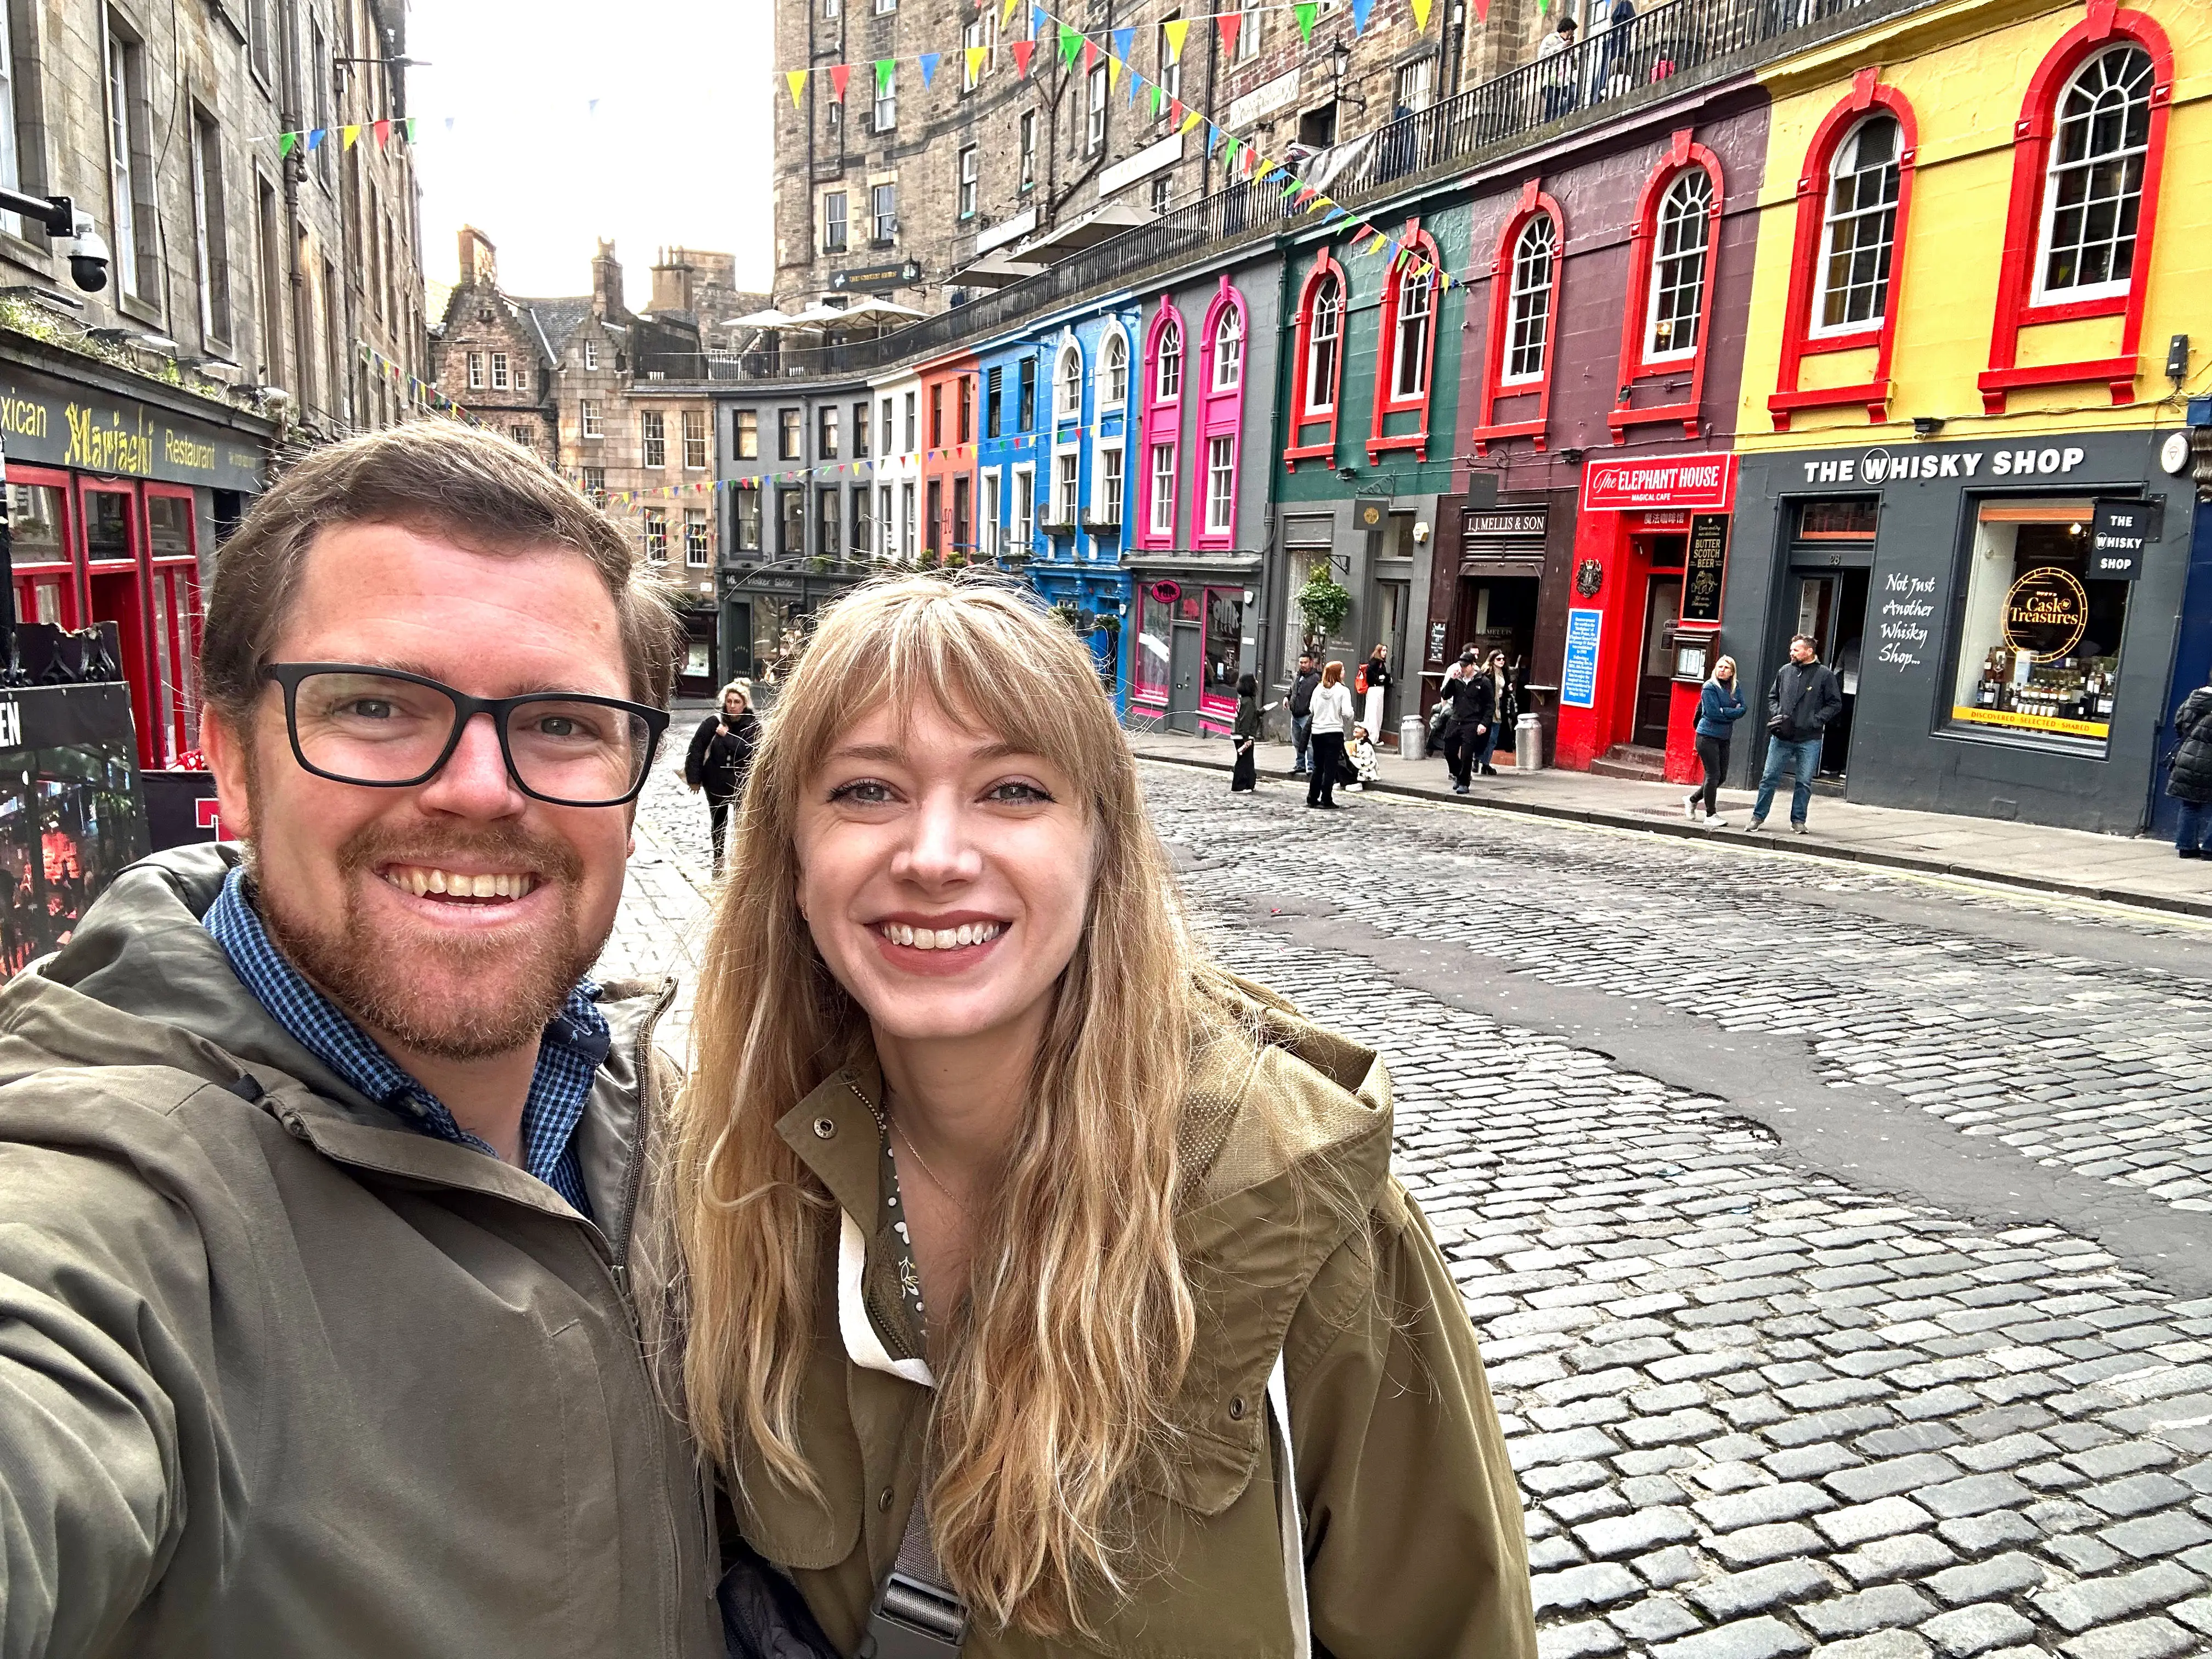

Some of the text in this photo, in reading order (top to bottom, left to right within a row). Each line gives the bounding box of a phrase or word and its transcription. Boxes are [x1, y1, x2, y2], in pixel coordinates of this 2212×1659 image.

[0, 386, 215, 476] xican Mariachi Restaurant
[1804, 447, 2084, 484] THE WHISKY SHOP
[1593, 466, 1720, 494] The ELEPHANT HOUSE
[1656, 493, 1672, 501] CAFE
[1514, 516, 1521, 530] &
[1523, 516, 1545, 531] SON
[2110, 515, 2133, 527] THE
[1695, 539, 1721, 549] BUTTER
[2096, 532, 2142, 550] WHISKY
[1693, 549, 1720, 558] SCOTCH
[1829, 554, 1840, 566] 28
[1697, 558, 1714, 568] BEER
[2100, 557, 2132, 569] SHOP
[1886, 572, 1936, 600] Not Just
[1882, 599, 1934, 617] Another
[2027, 597, 2063, 613] Cask
[2010, 607, 2079, 625] Treasures
[1881, 620, 1928, 650] Whisky
[1971, 711, 2090, 731] DISCOVERED SELECTED SHARED
